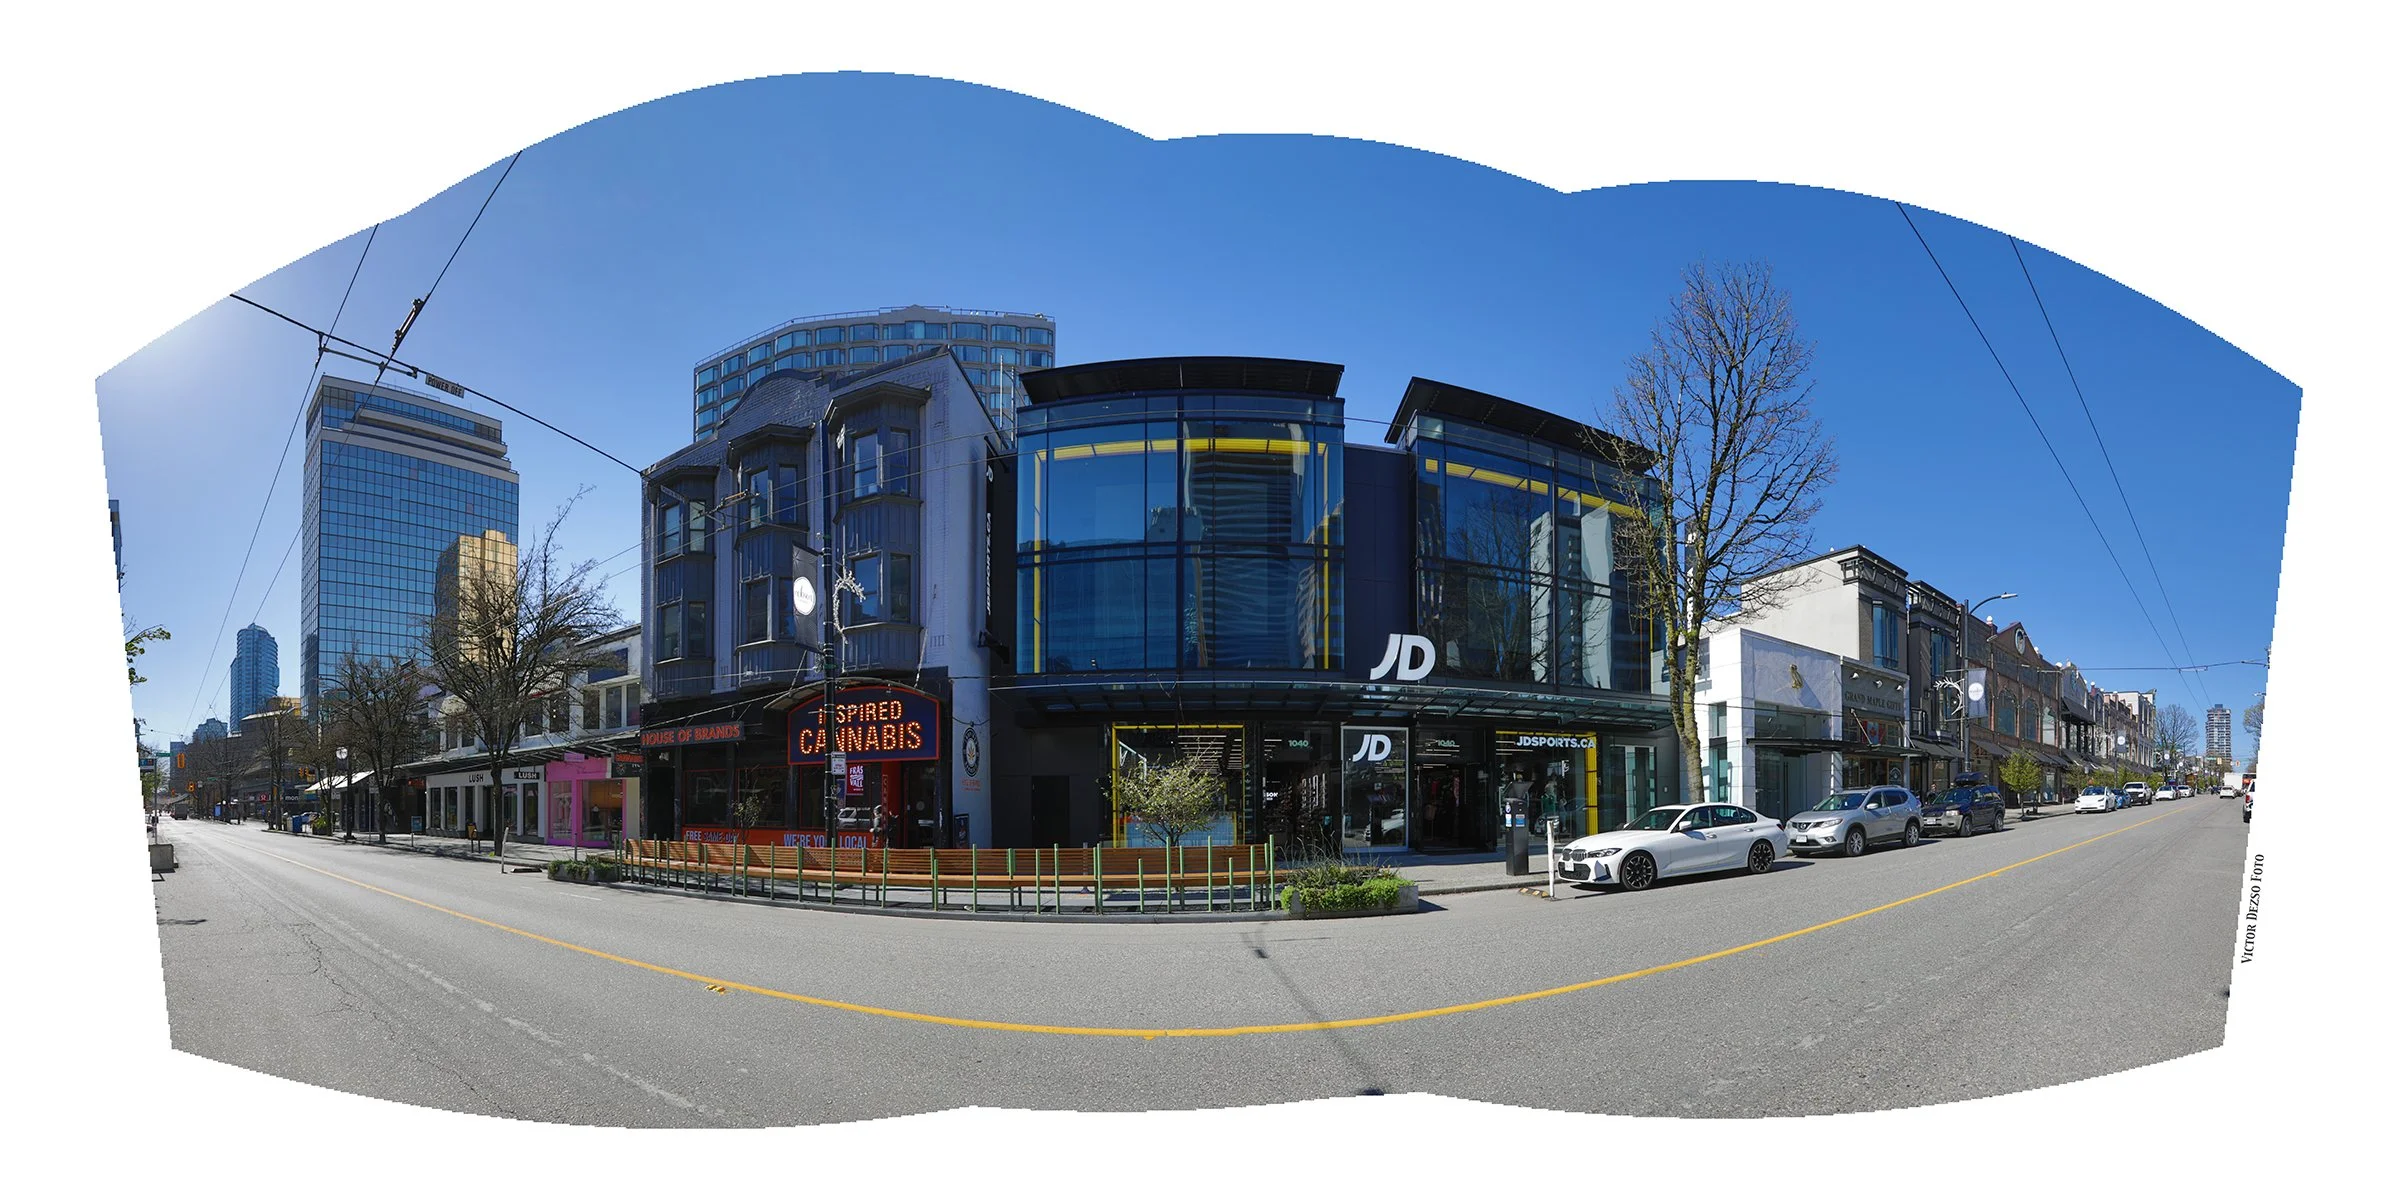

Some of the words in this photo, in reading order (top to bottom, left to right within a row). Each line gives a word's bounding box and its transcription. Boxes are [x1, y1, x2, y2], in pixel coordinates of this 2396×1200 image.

[1369, 633, 1436, 681] JD
[1844, 690, 1866, 704] GRAND
[1867, 695, 1885, 709] MAPLE
[818, 700, 902, 724] ISPIRED
[641, 730, 675, 746] HOUSE
[677, 728, 693, 743] OF
[694, 724, 740, 741] BRANDS
[800, 721, 921, 754] CANNABIS
[1288, 740, 1309, 748] 1040
[1516, 736, 1596, 748] JDSPORTS.CA
[1352, 734, 1392, 762] JD
[468, 773, 484, 783] LUSH
[686, 830, 702, 841] FREE
[783, 833, 811, 848] WE'RE
